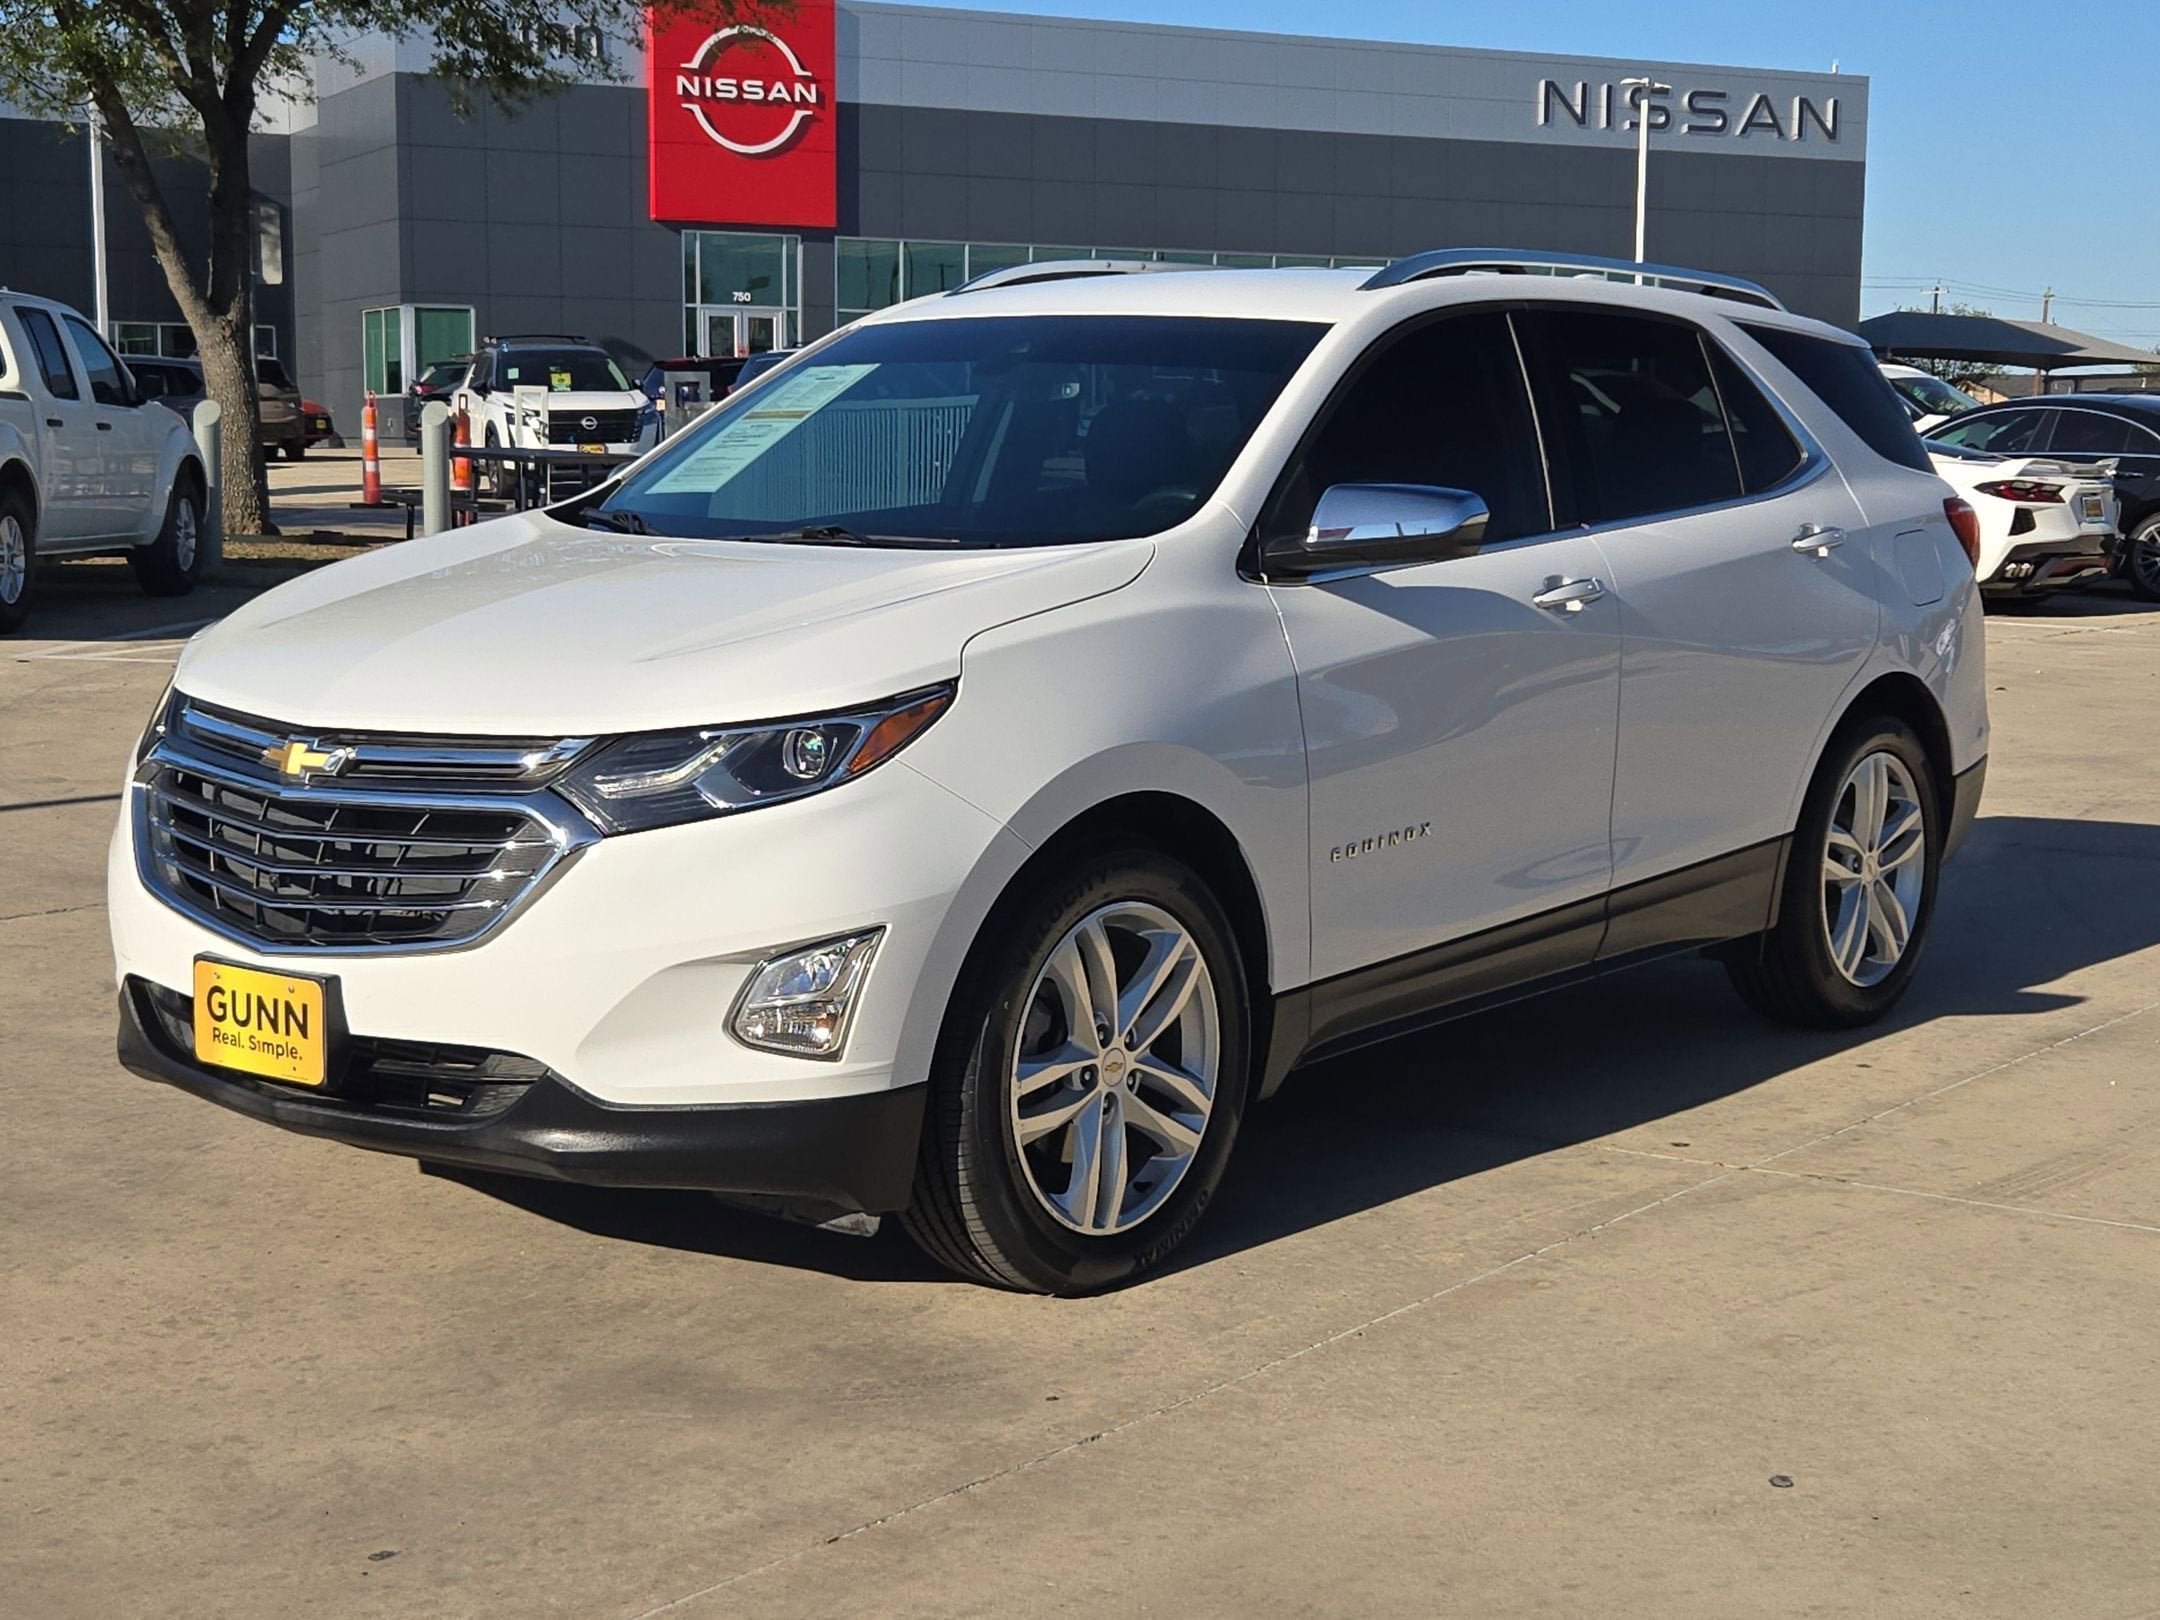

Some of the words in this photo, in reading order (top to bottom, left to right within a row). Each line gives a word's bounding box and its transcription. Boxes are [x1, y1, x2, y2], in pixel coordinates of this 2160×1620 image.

[676, 74, 817, 104] NISSAN
[1537, 78, 1840, 141] NISSAN
[732, 291, 752, 302] 750
[1330, 821, 1432, 863] EQUINOX
[207, 985, 309, 1039] GUNN
[212, 1026, 245, 1049] Real.
[249, 1035, 303, 1061] Simple.
